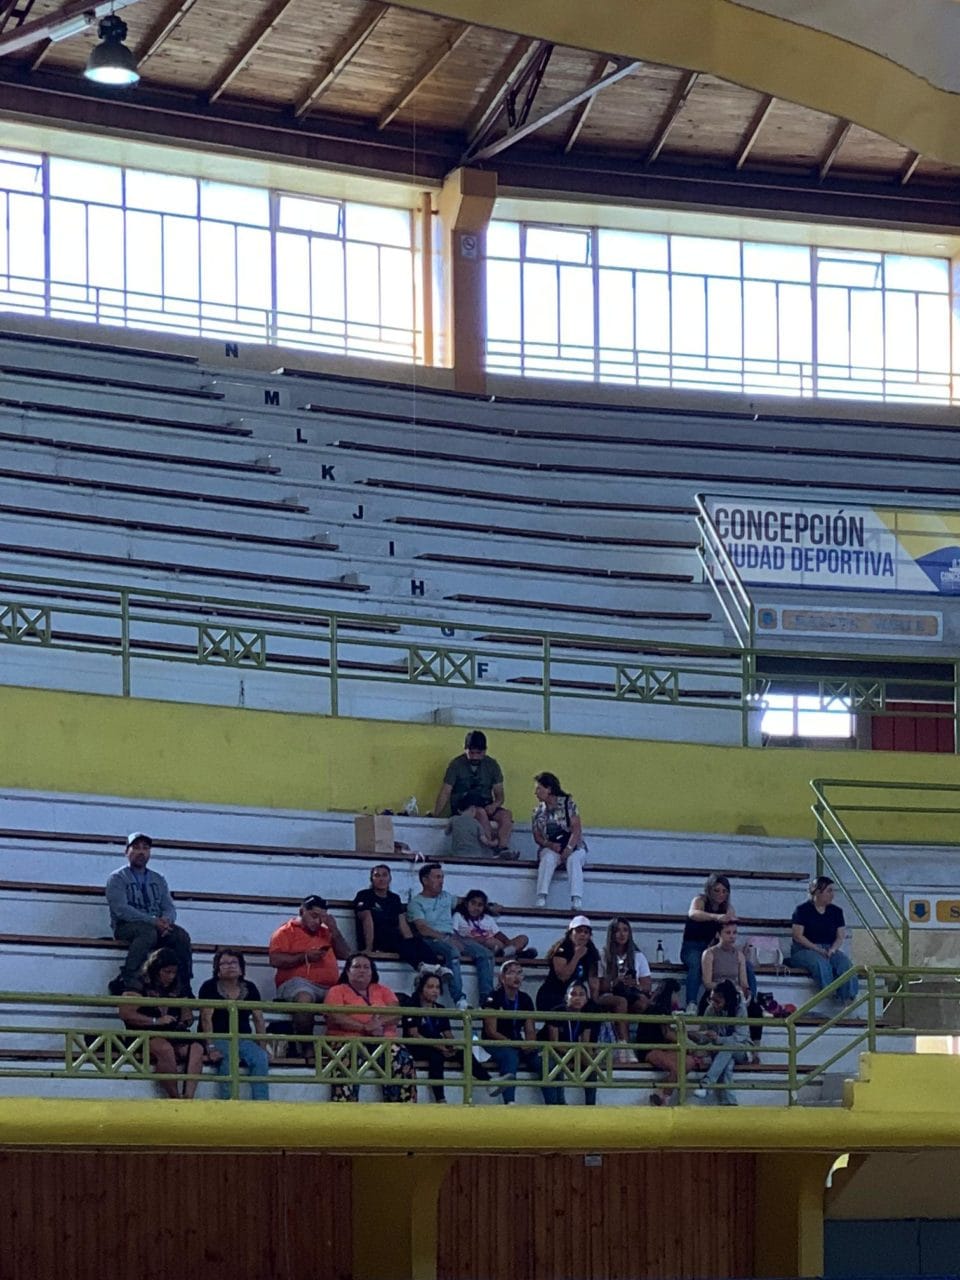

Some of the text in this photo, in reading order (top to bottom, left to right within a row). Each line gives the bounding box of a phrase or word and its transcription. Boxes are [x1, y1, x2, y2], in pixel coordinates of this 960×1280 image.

[225, 343, 239, 358] N
[264, 390, 280, 406] M
[296, 428, 308, 444] L
[321, 464, 335, 481] K
[352, 505, 364, 520] J
[715, 508, 864, 547] CONCEPCIÓN
[389, 541, 395, 556] I
[717, 543, 894, 577] IUDAD DEPORTIVA
[411, 579, 425, 596] H
[477, 662, 489, 678] F
